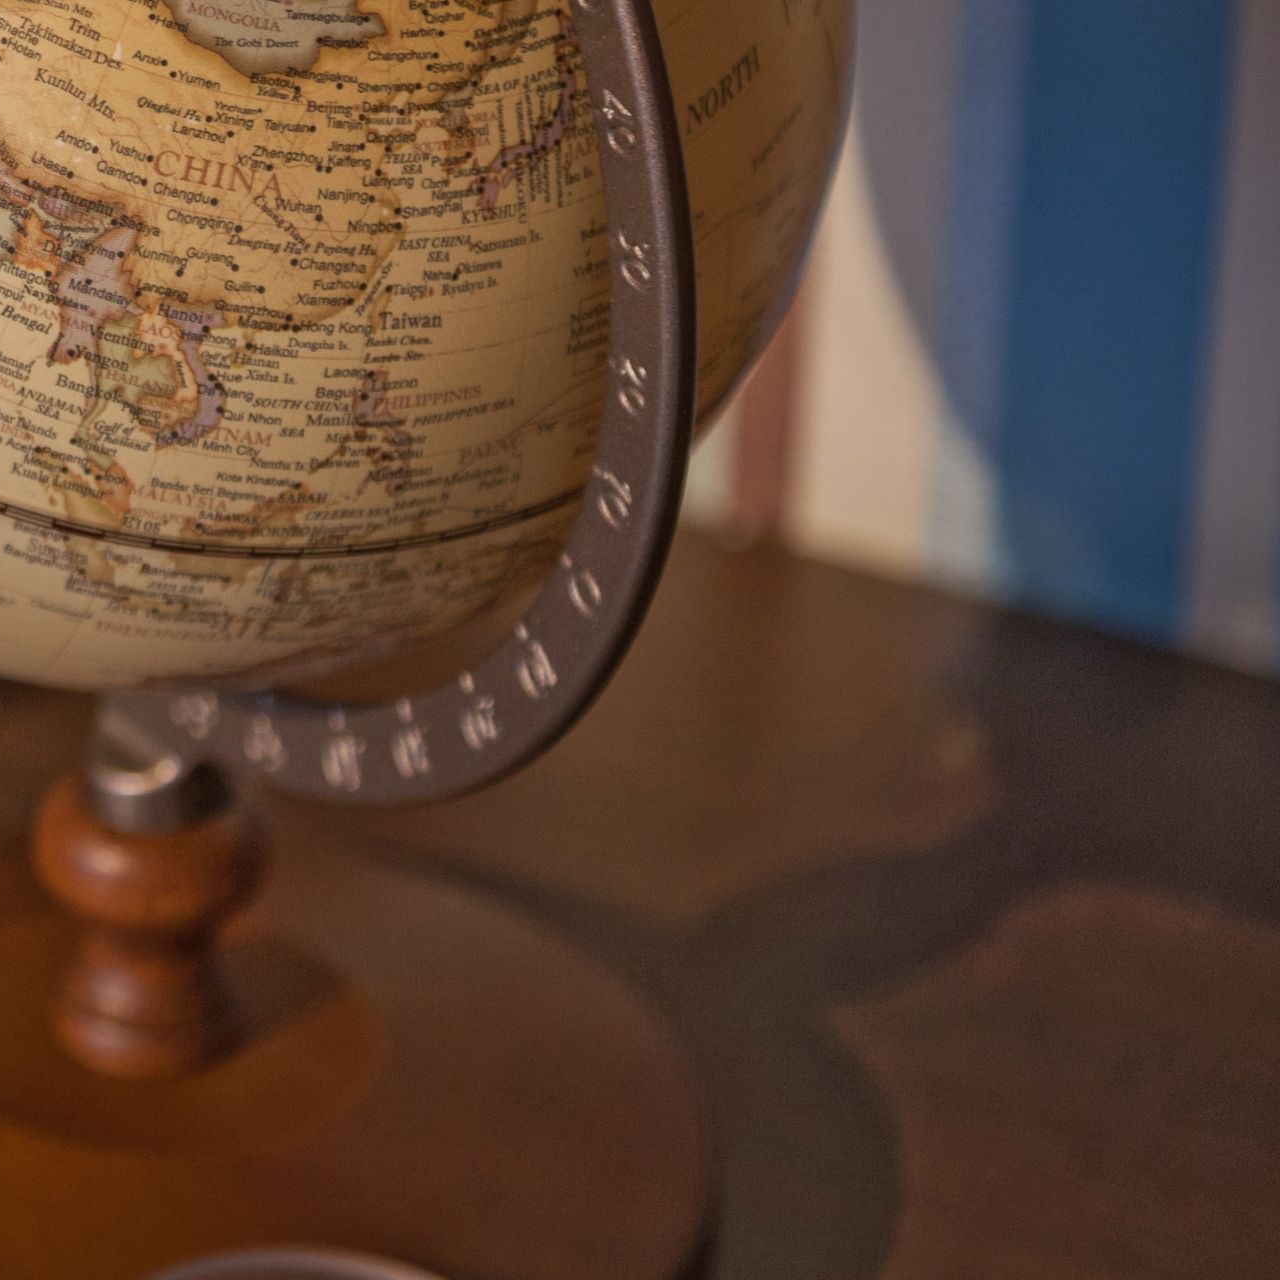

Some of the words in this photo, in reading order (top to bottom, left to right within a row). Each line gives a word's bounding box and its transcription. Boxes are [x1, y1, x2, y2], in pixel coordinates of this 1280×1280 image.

[155, 15, 189, 34] Hami
[188, 3, 281, 33] MONGOLIA
[400, 28, 438, 38] Harbin
[6, 38, 42, 60] Hotan
[214, 37, 234, 48] The
[236, 38, 263, 48] Gobi
[266, 38, 299, 48] Desert
[133, 50, 161, 66] Anxi
[367, 50, 432, 62] Changchun
[432, 61, 465, 72] Siping
[178, 70, 220, 91] Yumen
[358, 82, 415, 94] Shenyang
[685, 43, 760, 136] NORTH
[306, 101, 353, 115] Beijing
[215, 112, 254, 129] Xining
[264, 120, 310, 133] Taiyuan
[602, 89, 636, 156] 40
[172, 122, 227, 144] Lanzhou
[55, 130, 91, 152] Amdo
[328, 141, 360, 152] Jinan
[108, 139, 147, 162] Yushu
[252, 145, 323, 164] Zhengzhou
[386, 152, 429, 163] YELLOW
[31, 151, 67, 176] Lhasa
[328, 155, 371, 168] Kaifeng
[431, 155, 466, 166] Pusan
[96, 160, 142, 185] Qamdo
[152, 150, 282, 200] CHINA
[401, 165, 422, 175] SEA
[153, 183, 210, 205] Chengdu
[317, 188, 369, 201] Nanjing
[274, 199, 322, 214] Wuhan
[404, 201, 463, 217] Shanghai
[167, 209, 235, 234] Chongqing
[347, 220, 394, 233] Ningbo
[398, 239, 429, 248] EAST
[432, 235, 471, 247] CHINA
[136, 240, 188, 268] Kunming
[186, 247, 234, 268] Guiyang
[427, 251, 450, 262] SEA
[299, 258, 366, 273] Changsha
[69, 279, 133, 306] Mandalay
[136, 279, 189, 301] Lancang
[224, 281, 257, 292] Guilin
[313, 280, 359, 290] Fuzhou
[296, 294, 345, 306] Xiamen
[159, 303, 205, 323] Hanoi
[214, 299, 285, 320] Guangzhou
[1, 303, 53, 335] Bengal
[238, 317, 282, 330] Macau
[379, 311, 442, 331] Taiwan
[300, 322, 335, 334] Hong
[338, 322, 373, 335] Kong
[74, 345, 129, 371] Yangon
[252, 344, 298, 358] Haikou
[234, 354, 280, 368] Hainan
[217, 371, 242, 382] Hue
[55, 375, 123, 403] Bangkok
[17, 387, 86, 417] ANDAMAN
[252, 398, 302, 410] SOUTH
[305, 401, 351, 412] CHINA
[36, 403, 61, 420] SEA
[222, 410, 243, 421] Qui
[247, 412, 282, 425] Nhon
[18, 417, 57, 439] Islands
[94, 420, 120, 434] Gulf
[122, 422, 136, 434] of
[280, 428, 304, 438] SEA
[98, 432, 150, 452] Thailand
[101, 472, 129, 486] Ipoh
[217, 472, 242, 482] Kota
[245, 473, 294, 487] Kinabalu
[150, 478, 189, 493] Bandar
[192, 483, 214, 495] Seri
[218, 488, 265, 504] Begawan
